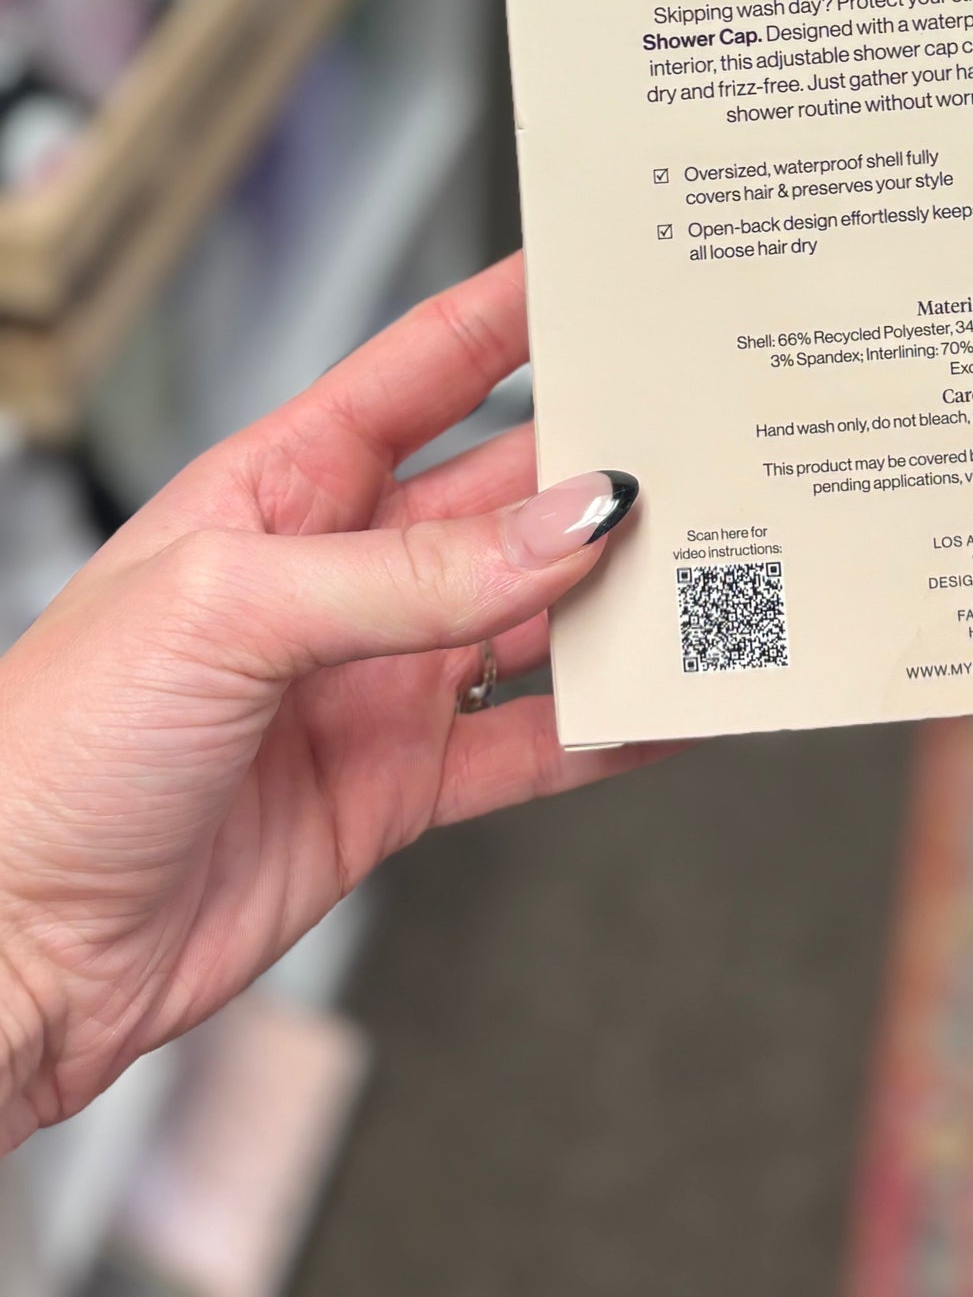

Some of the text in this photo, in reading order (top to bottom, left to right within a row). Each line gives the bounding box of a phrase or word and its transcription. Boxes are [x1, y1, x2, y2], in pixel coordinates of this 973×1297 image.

[653, 3, 734, 27] Skipping
[642, 32, 717, 52] Shower
[718, 27, 763, 48] Cap.
[765, 18, 854, 44] Designed
[855, 16, 895, 36] with
[897, 18, 911, 33] a
[648, 56, 718, 78] interior,
[719, 52, 754, 72] this
[755, 45, 851, 71] adjustable
[852, 43, 922, 63] shower
[923, 41, 960, 59] cap
[683, 148, 940, 183] Oversized, waterproof shell fully
[685, 170, 954, 206] covers hair & preserves your style
[687, 215, 782, 241] Open-back
[782, 212, 839, 232] design
[839, 205, 931, 227] effortlessly
[688, 237, 819, 262] all loose hair dry
[736, 333, 776, 351] Shell:
[777, 331, 812, 348] 66%
[813, 325, 882, 346] Recycled
[883, 322, 954, 341] Polyester,
[769, 352, 795, 369] 3%
[795, 348, 865, 369] Spandex;
[865, 343, 940, 362] Interlining:
[755, 421, 795, 439] Hand
[795, 419, 836, 436] wash
[836, 416, 871, 435] only,
[870, 415, 892, 431] do
[892, 413, 918, 429] not
[918, 409, 972, 427] bleach,
[686, 525, 769, 543] Scan here for
[932, 534, 964, 550] LOS
[672, 542, 783, 561] video instructions:
